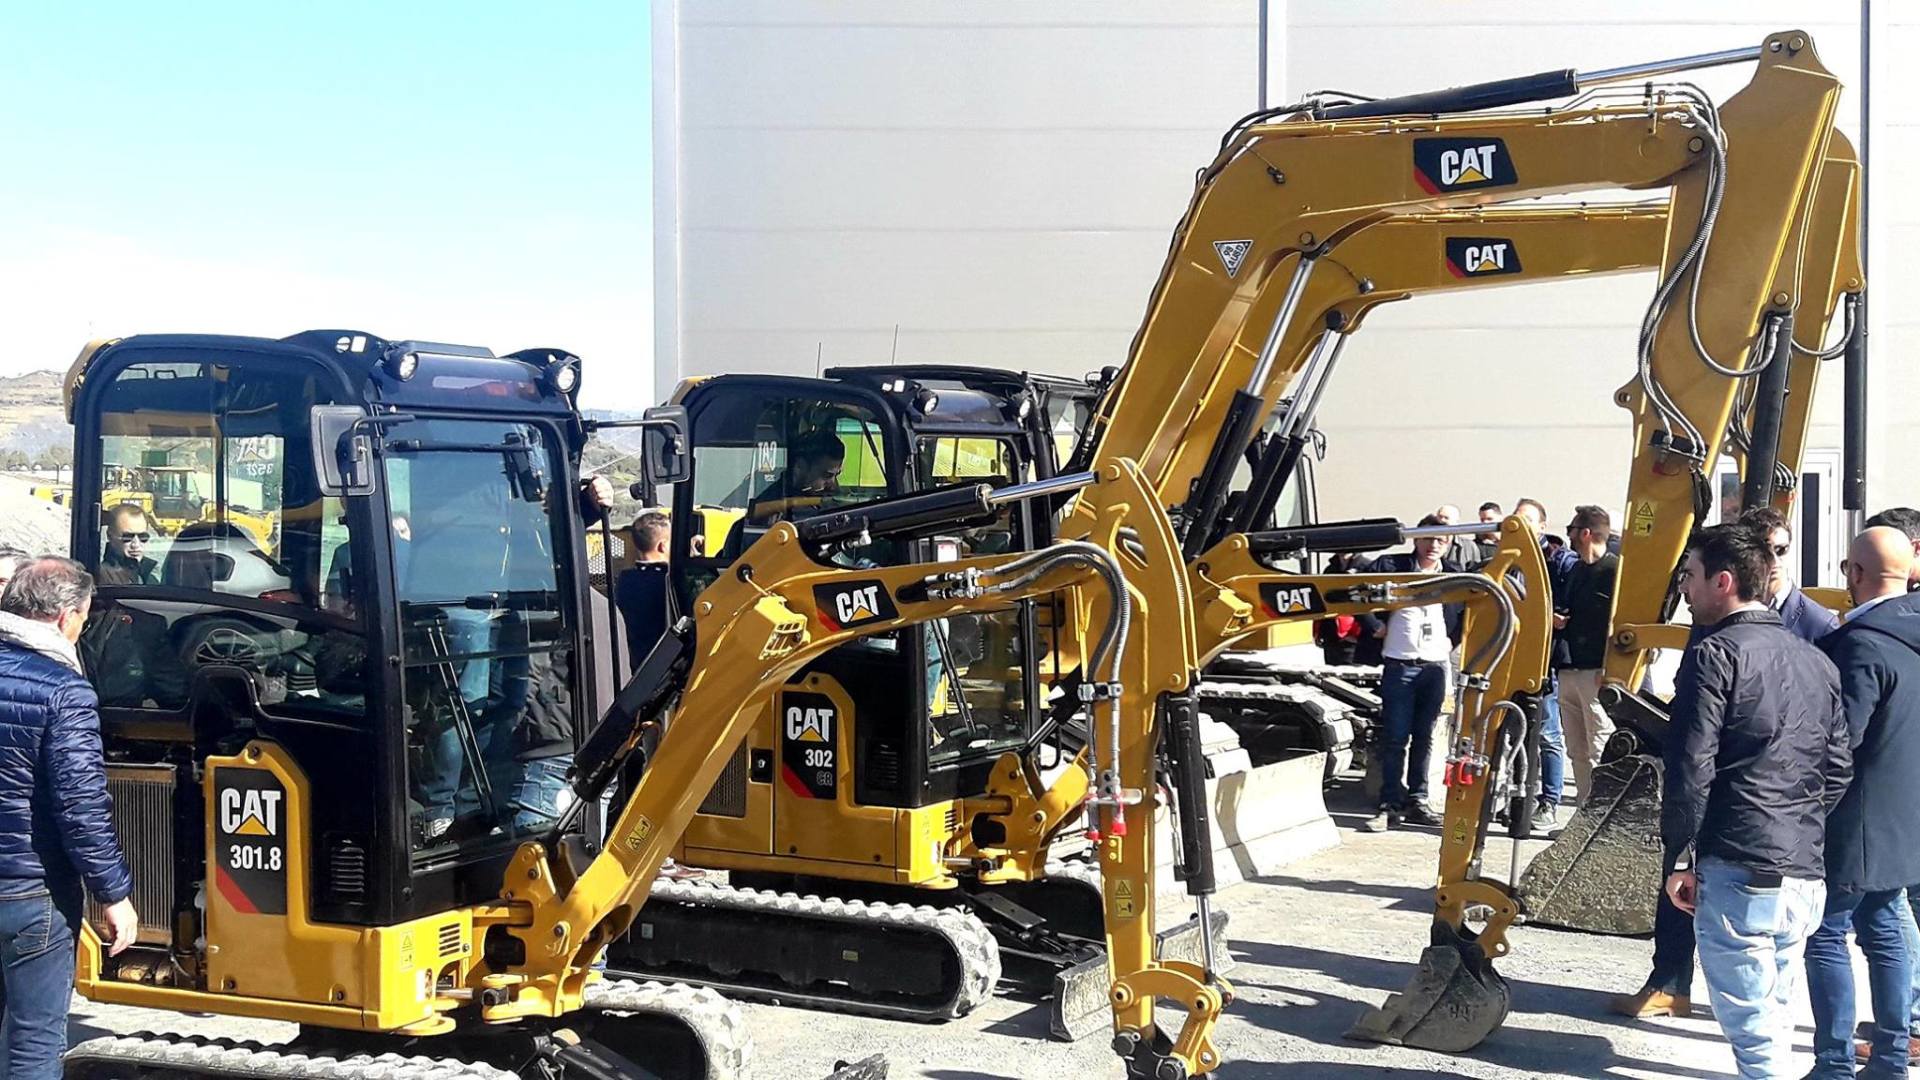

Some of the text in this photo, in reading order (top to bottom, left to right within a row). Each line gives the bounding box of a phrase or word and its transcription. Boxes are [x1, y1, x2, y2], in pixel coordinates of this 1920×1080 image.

[1440, 144, 1497, 185] CAT
[1465, 243, 1507, 272] CAT
[836, 585, 880, 623] CAT
[1276, 587, 1312, 613] CAT
[786, 706, 833, 742] CAT
[805, 748, 833, 768] 302
[816, 770, 833, 786] CR
[220, 787, 281, 836] CAT
[230, 844, 282, 871] 301.8
